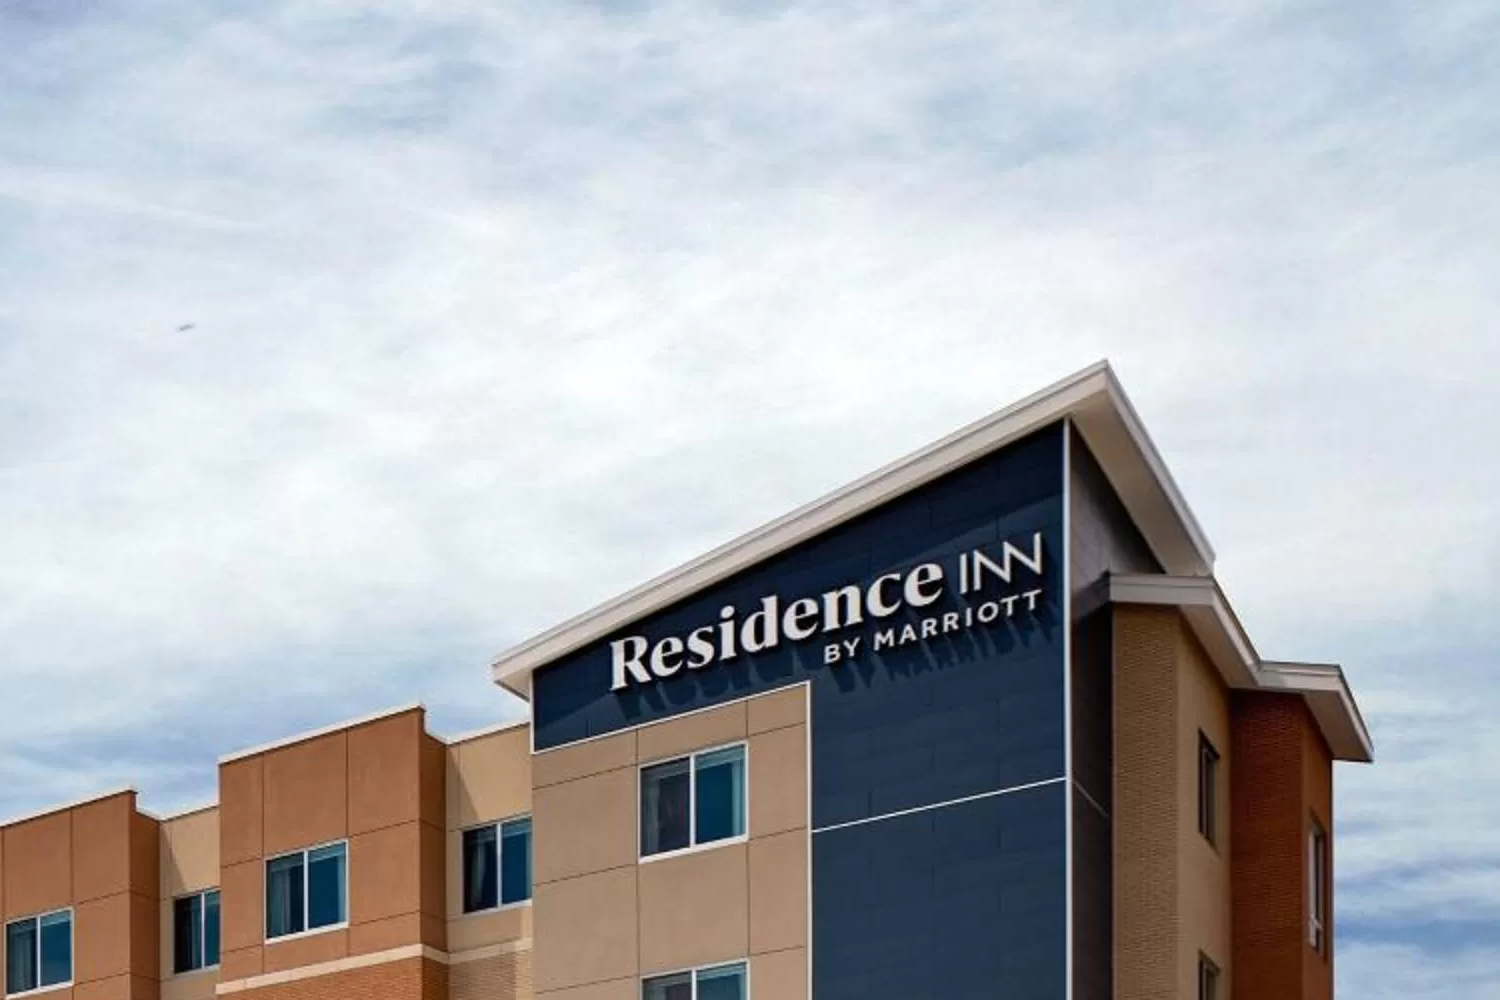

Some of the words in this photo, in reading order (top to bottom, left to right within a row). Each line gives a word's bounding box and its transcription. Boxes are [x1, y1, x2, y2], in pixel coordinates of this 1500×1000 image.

[610, 562, 943, 691] Residence
[959, 531, 1042, 594] INN
[822, 636, 861, 664] BY
[873, 588, 1043, 651] MARRIOTT
